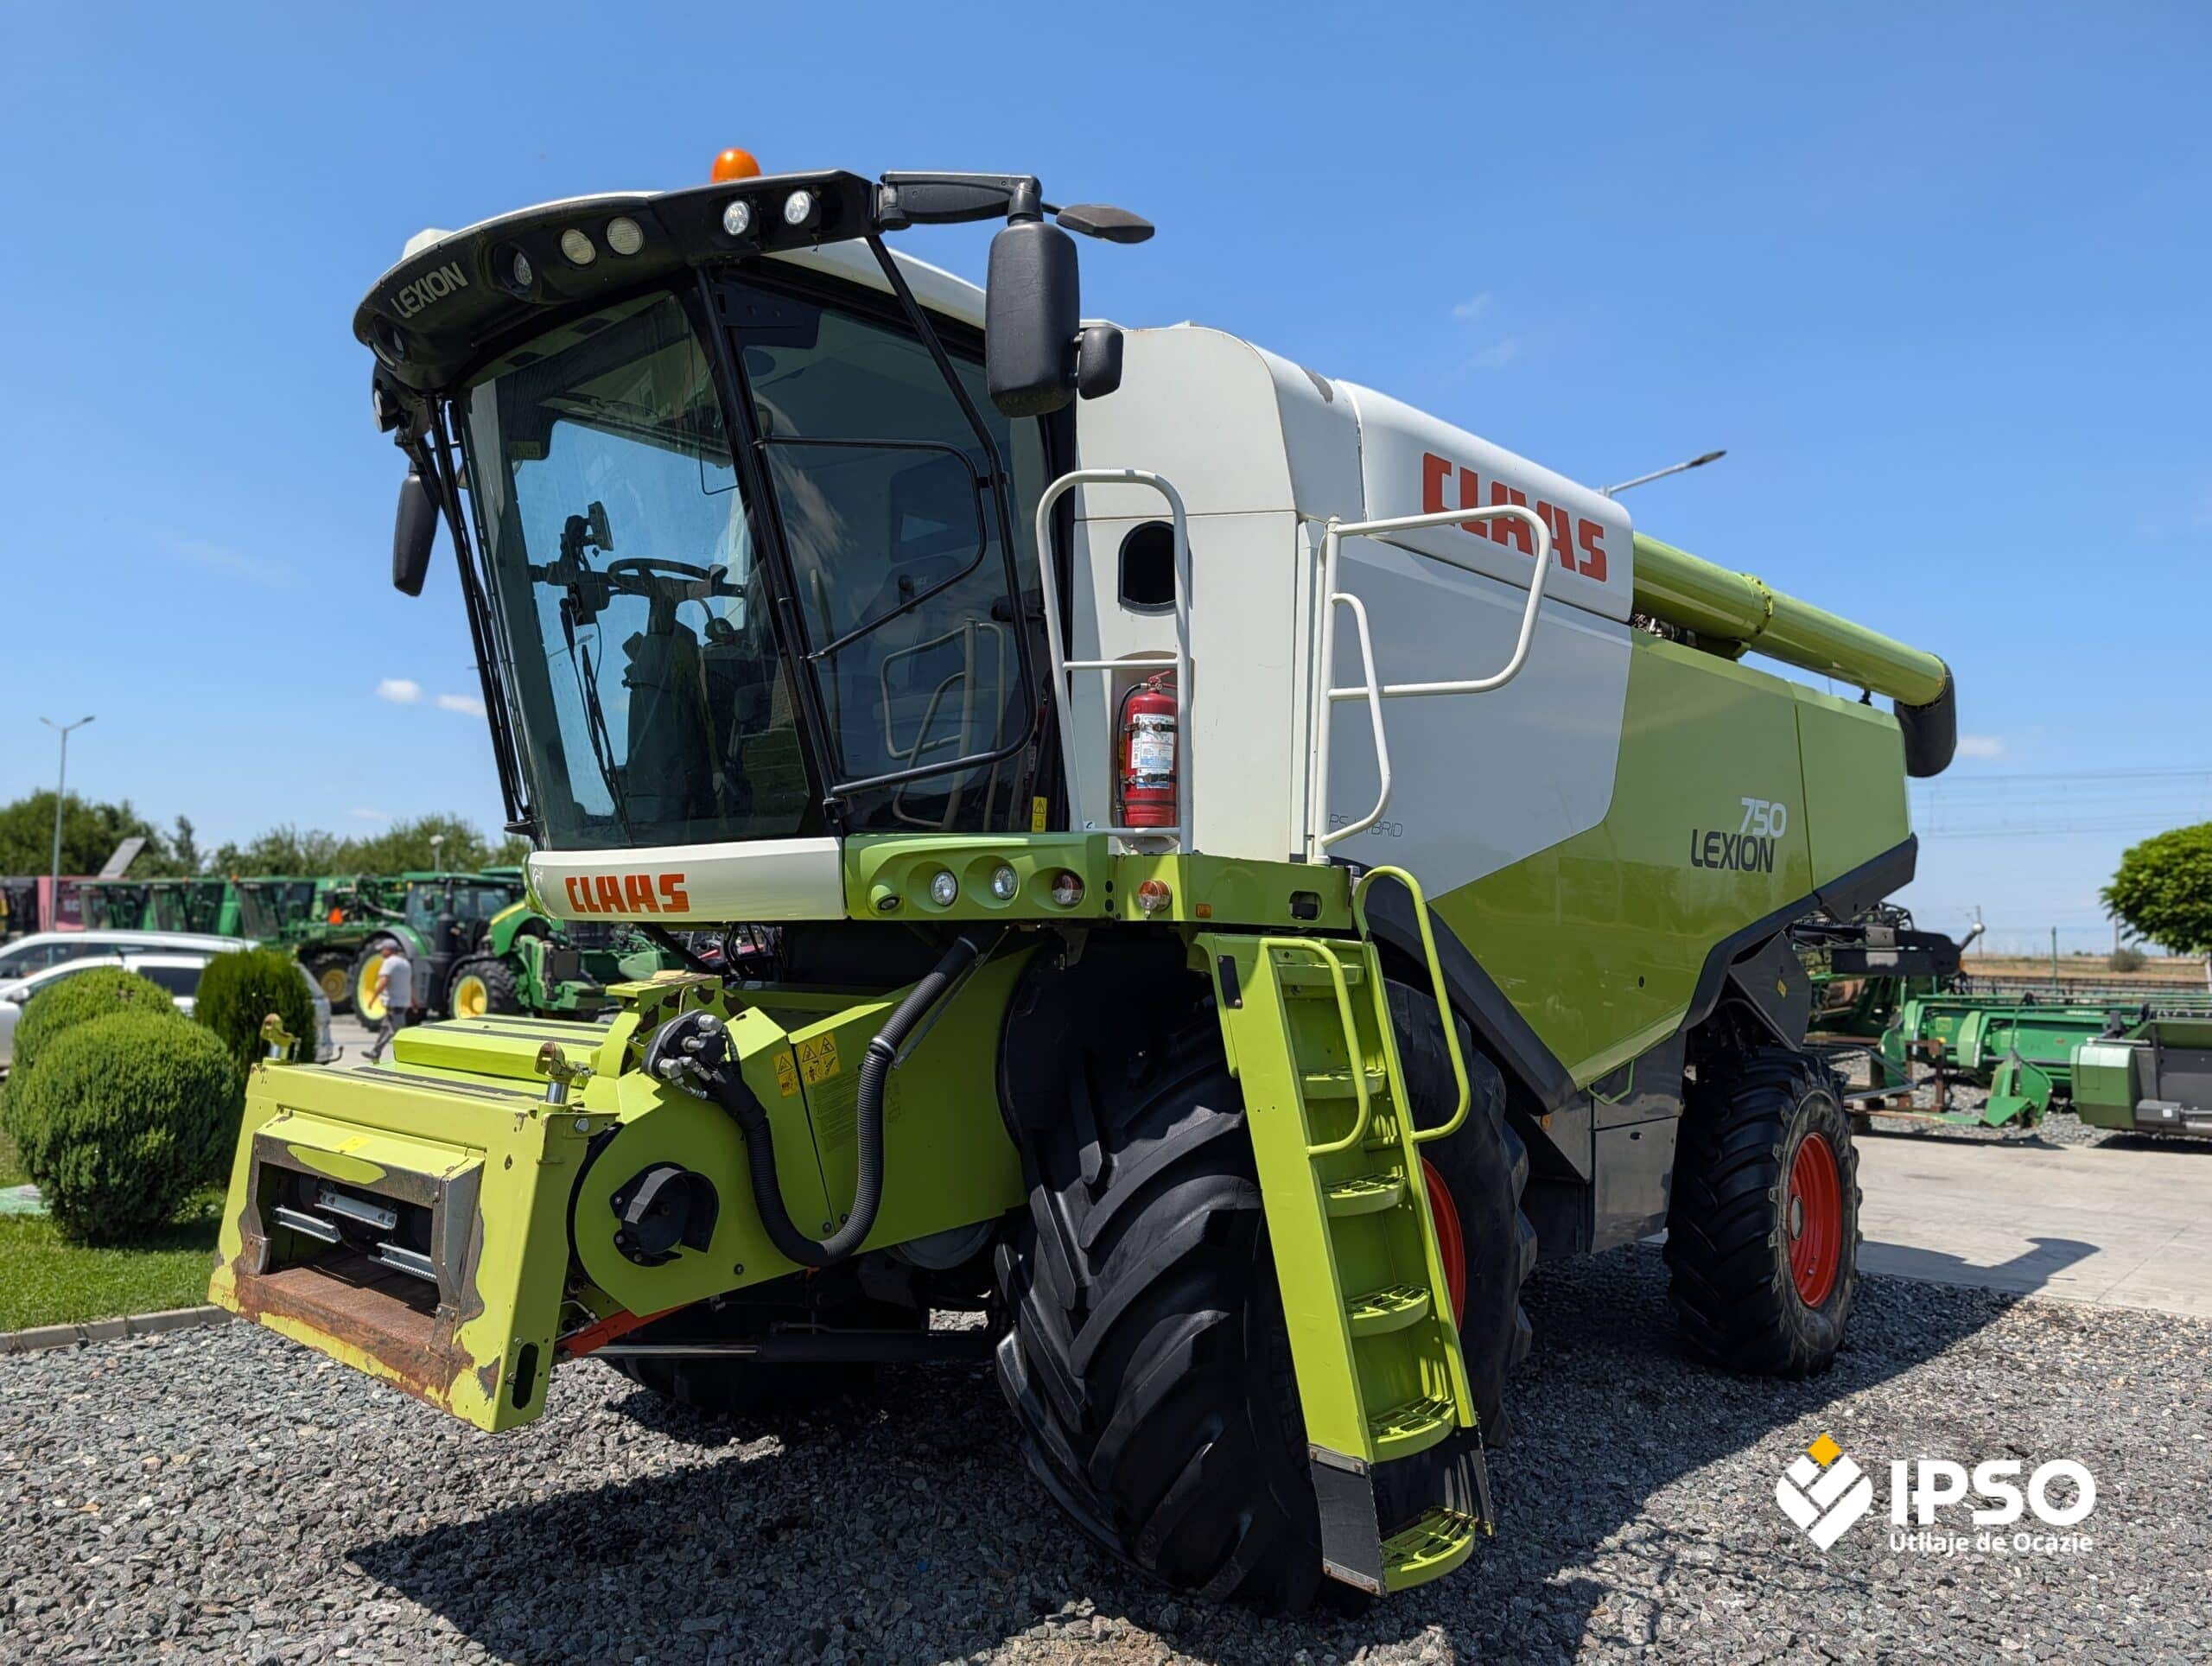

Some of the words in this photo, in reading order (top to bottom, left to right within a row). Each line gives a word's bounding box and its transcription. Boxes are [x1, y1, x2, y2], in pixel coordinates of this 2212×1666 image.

[391, 261, 468, 318] LEXION
[1423, 452, 1607, 582] CLAAS
[1740, 797, 1787, 837] 750
[1690, 829, 1775, 873] LEXION
[565, 874, 690, 912] CLAAS
